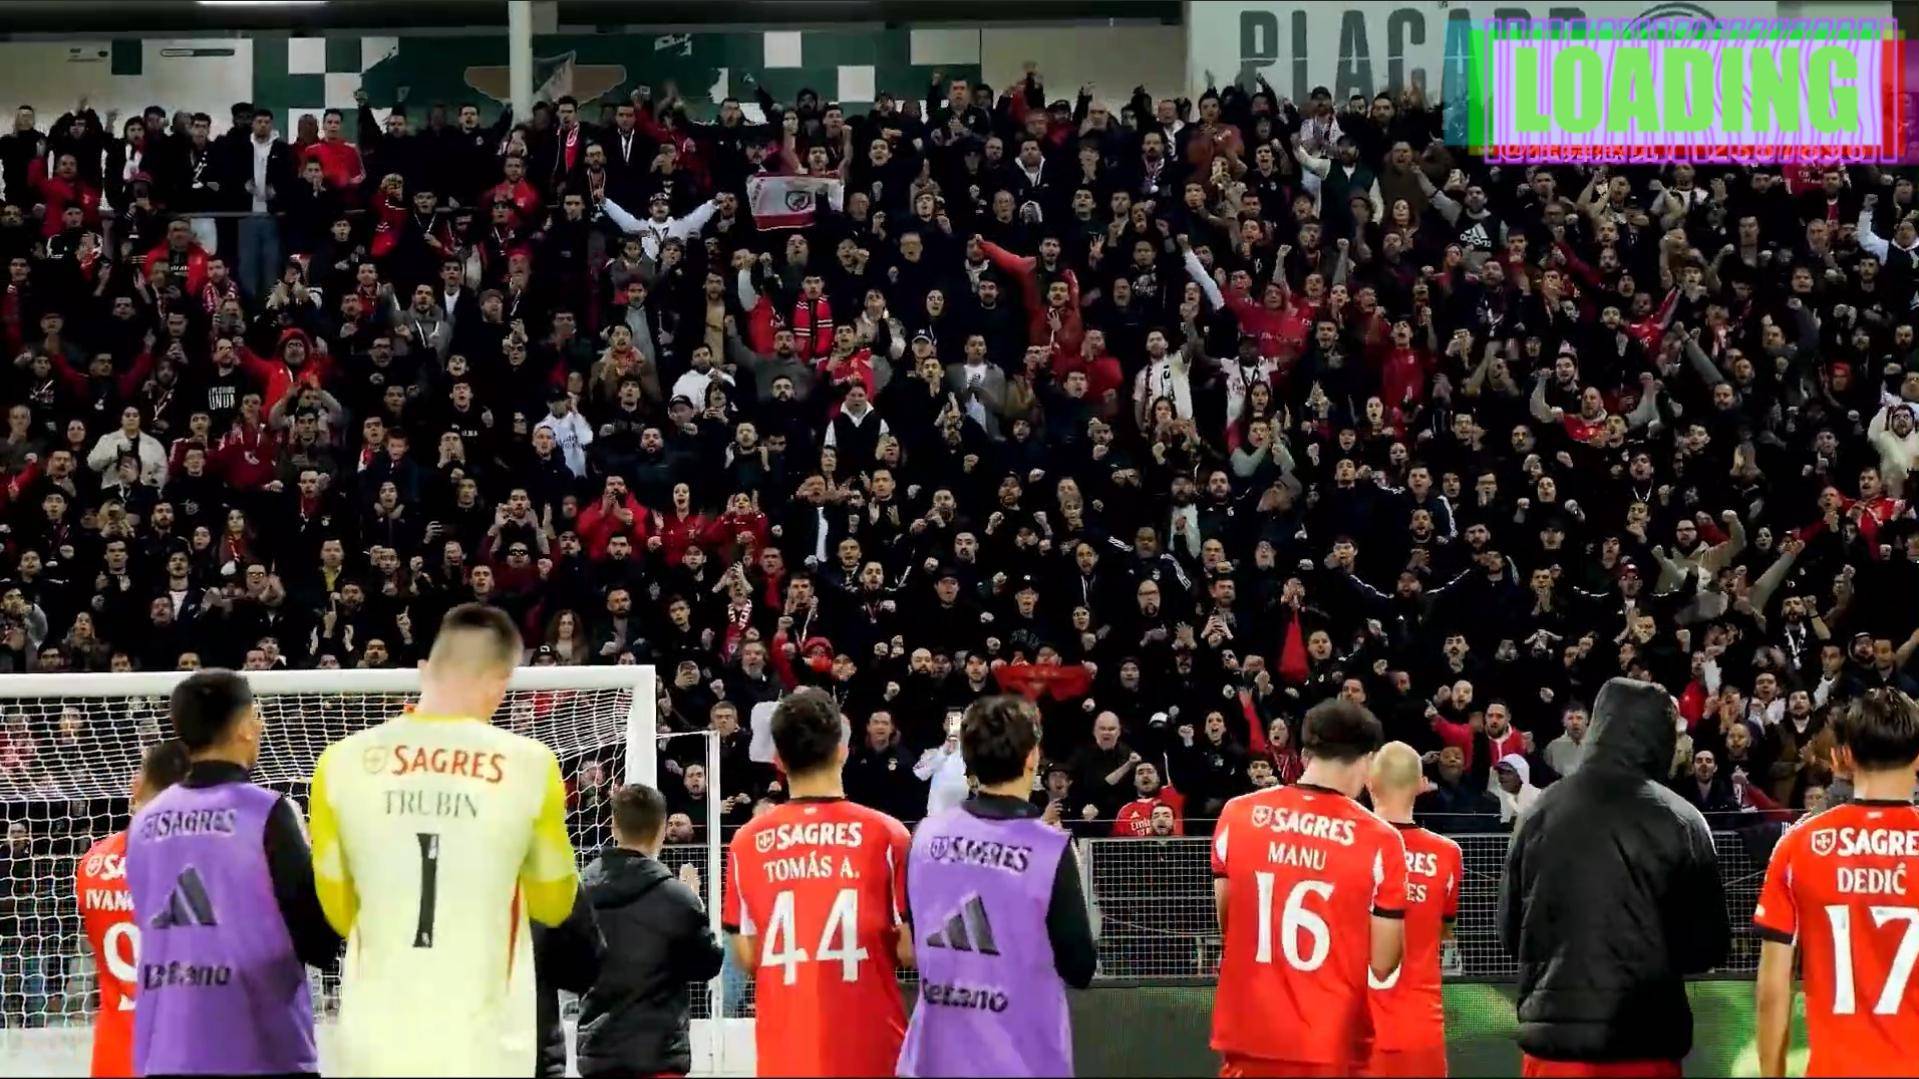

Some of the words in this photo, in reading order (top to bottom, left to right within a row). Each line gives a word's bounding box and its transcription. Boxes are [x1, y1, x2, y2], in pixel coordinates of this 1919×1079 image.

[391, 744, 506, 784] SAGRES
[384, 789, 478, 819] TRUBIN
[776, 821, 863, 851] SAGRES
[1271, 807, 1357, 847] SAGRES
[1836, 827, 1919, 857] SAGRE
[763, 850, 832, 883] TOMÁS
[840, 855, 860, 879] A.
[1268, 841, 1327, 871] MANU
[1404, 852, 1438, 877] RES
[413, 833, 439, 948] 1
[1406, 883, 1428, 903] ES
[1836, 862, 1908, 895] DEDIĆ
[85, 888, 135, 911] IVAN
[761, 888, 869, 986] 44
[1255, 870, 1335, 972] 16
[1824, 904, 1919, 1015] 17
